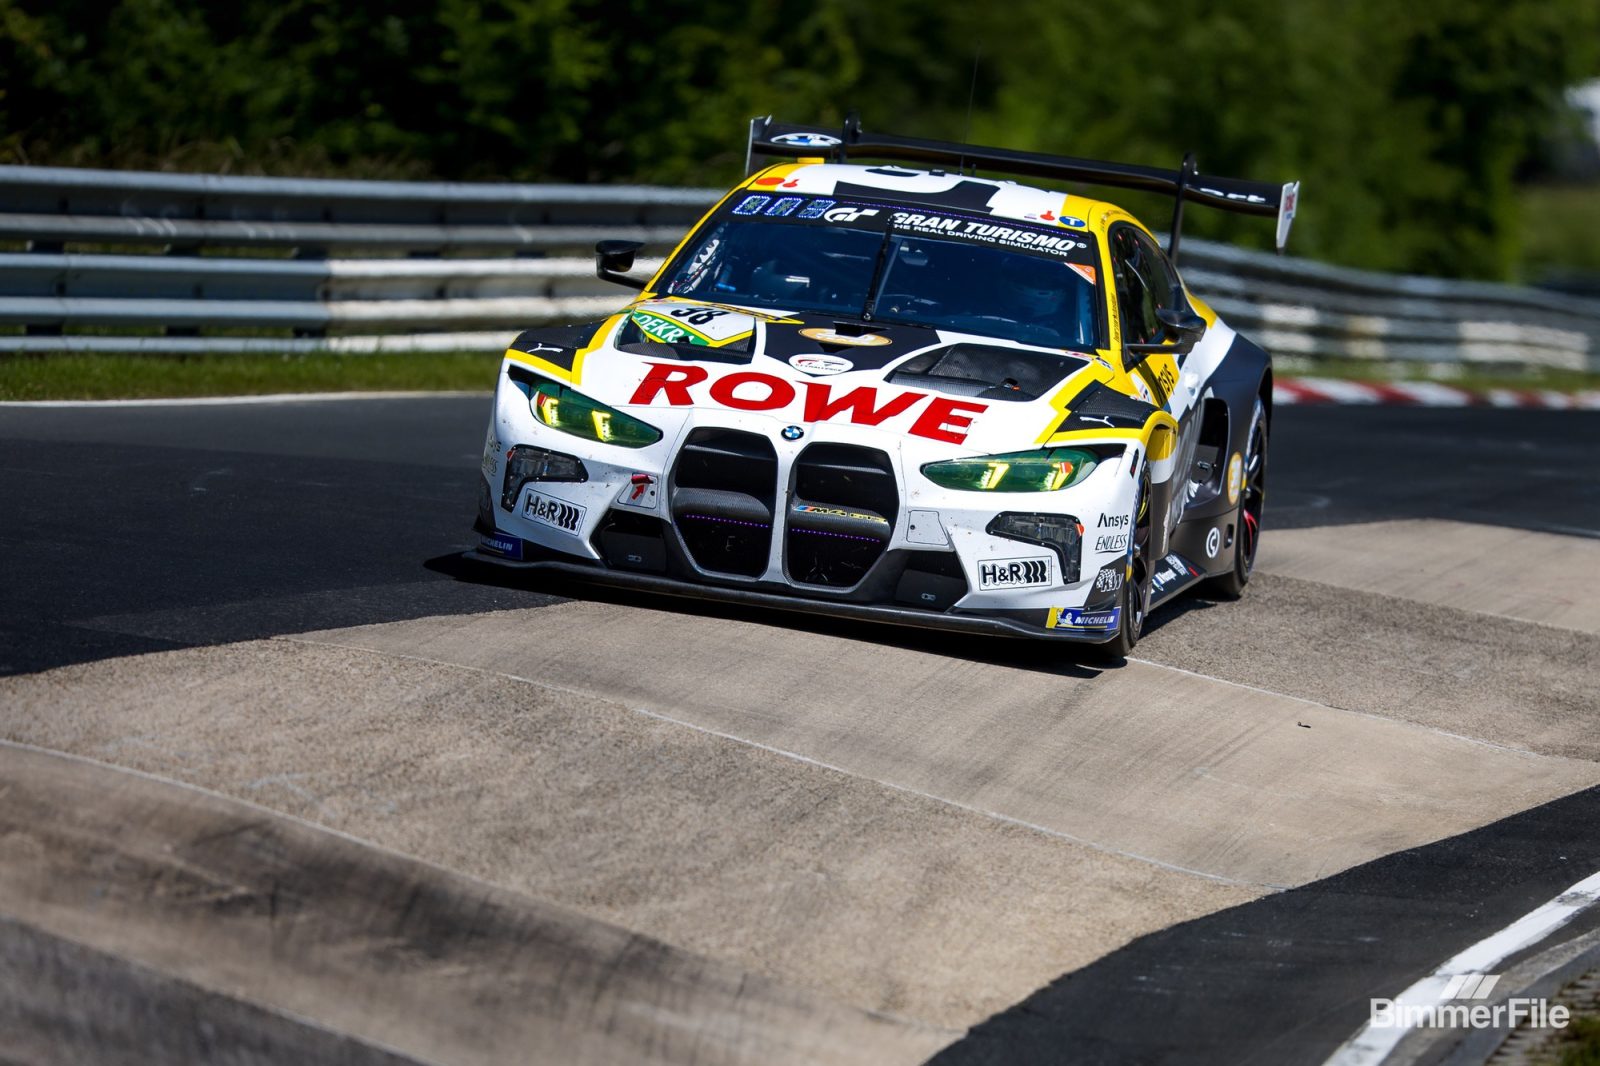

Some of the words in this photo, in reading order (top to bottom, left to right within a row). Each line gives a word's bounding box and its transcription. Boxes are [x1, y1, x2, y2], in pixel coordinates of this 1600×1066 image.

[887, 212, 963, 231] GRAN
[913, 226, 944, 235] REAL
[947, 230, 996, 243] DRIVING
[998, 239, 1068, 257] SIMULATOR
[628, 361, 989, 445] ROWE
[525, 493, 558, 521] H&R
[1097, 513, 1129, 529] Ansys
[1095, 533, 1128, 551] ENDLESS
[981, 563, 1023, 584] H&R
[1075, 615, 1115, 625] MICHELIN
